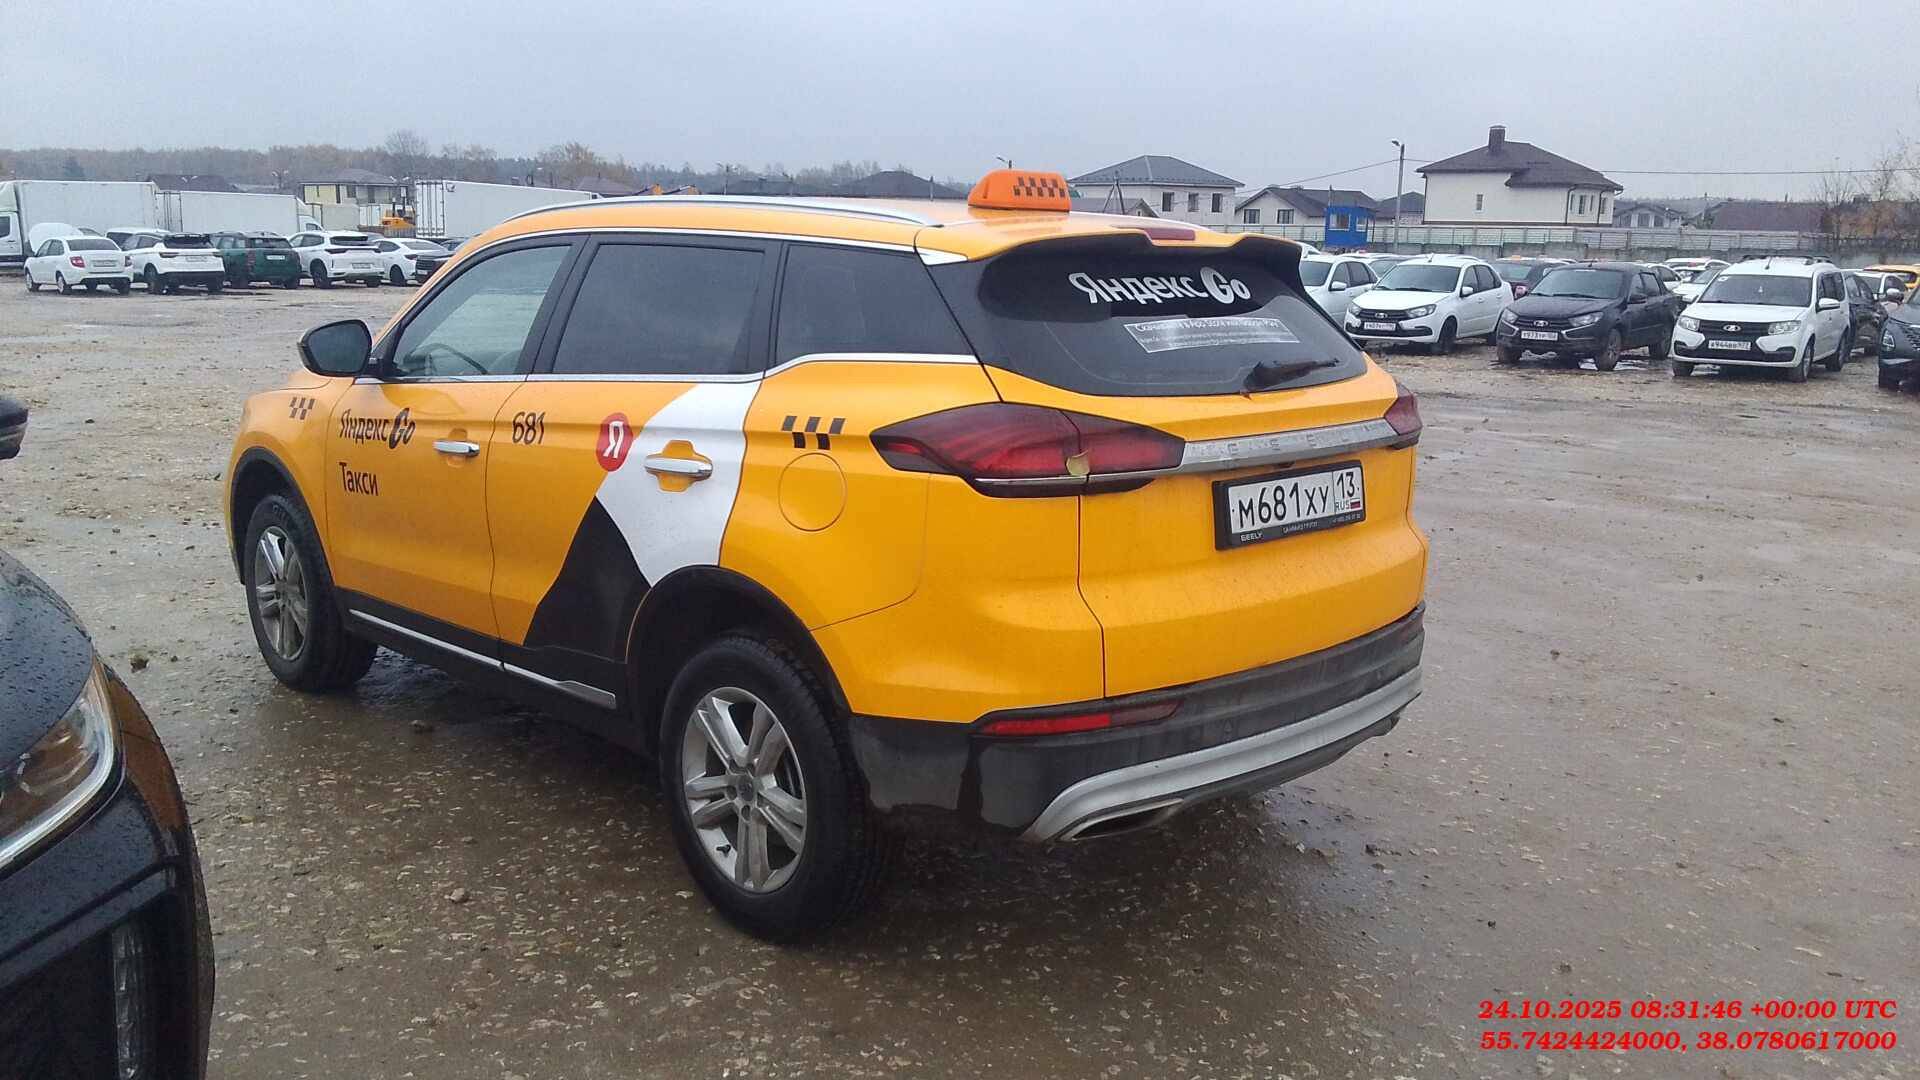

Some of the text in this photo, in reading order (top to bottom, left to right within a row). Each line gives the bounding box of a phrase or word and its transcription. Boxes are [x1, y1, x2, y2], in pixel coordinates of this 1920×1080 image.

[1068, 266, 1251, 304] Яндекс Go
[339, 407, 416, 449] Яндекс Go
[512, 411, 546, 445] 681
[602, 420, 625, 459] Я
[339, 461, 379, 496] Такси
[1335, 500, 1350, 510] RUS
[1240, 531, 1263, 542] GEELY
